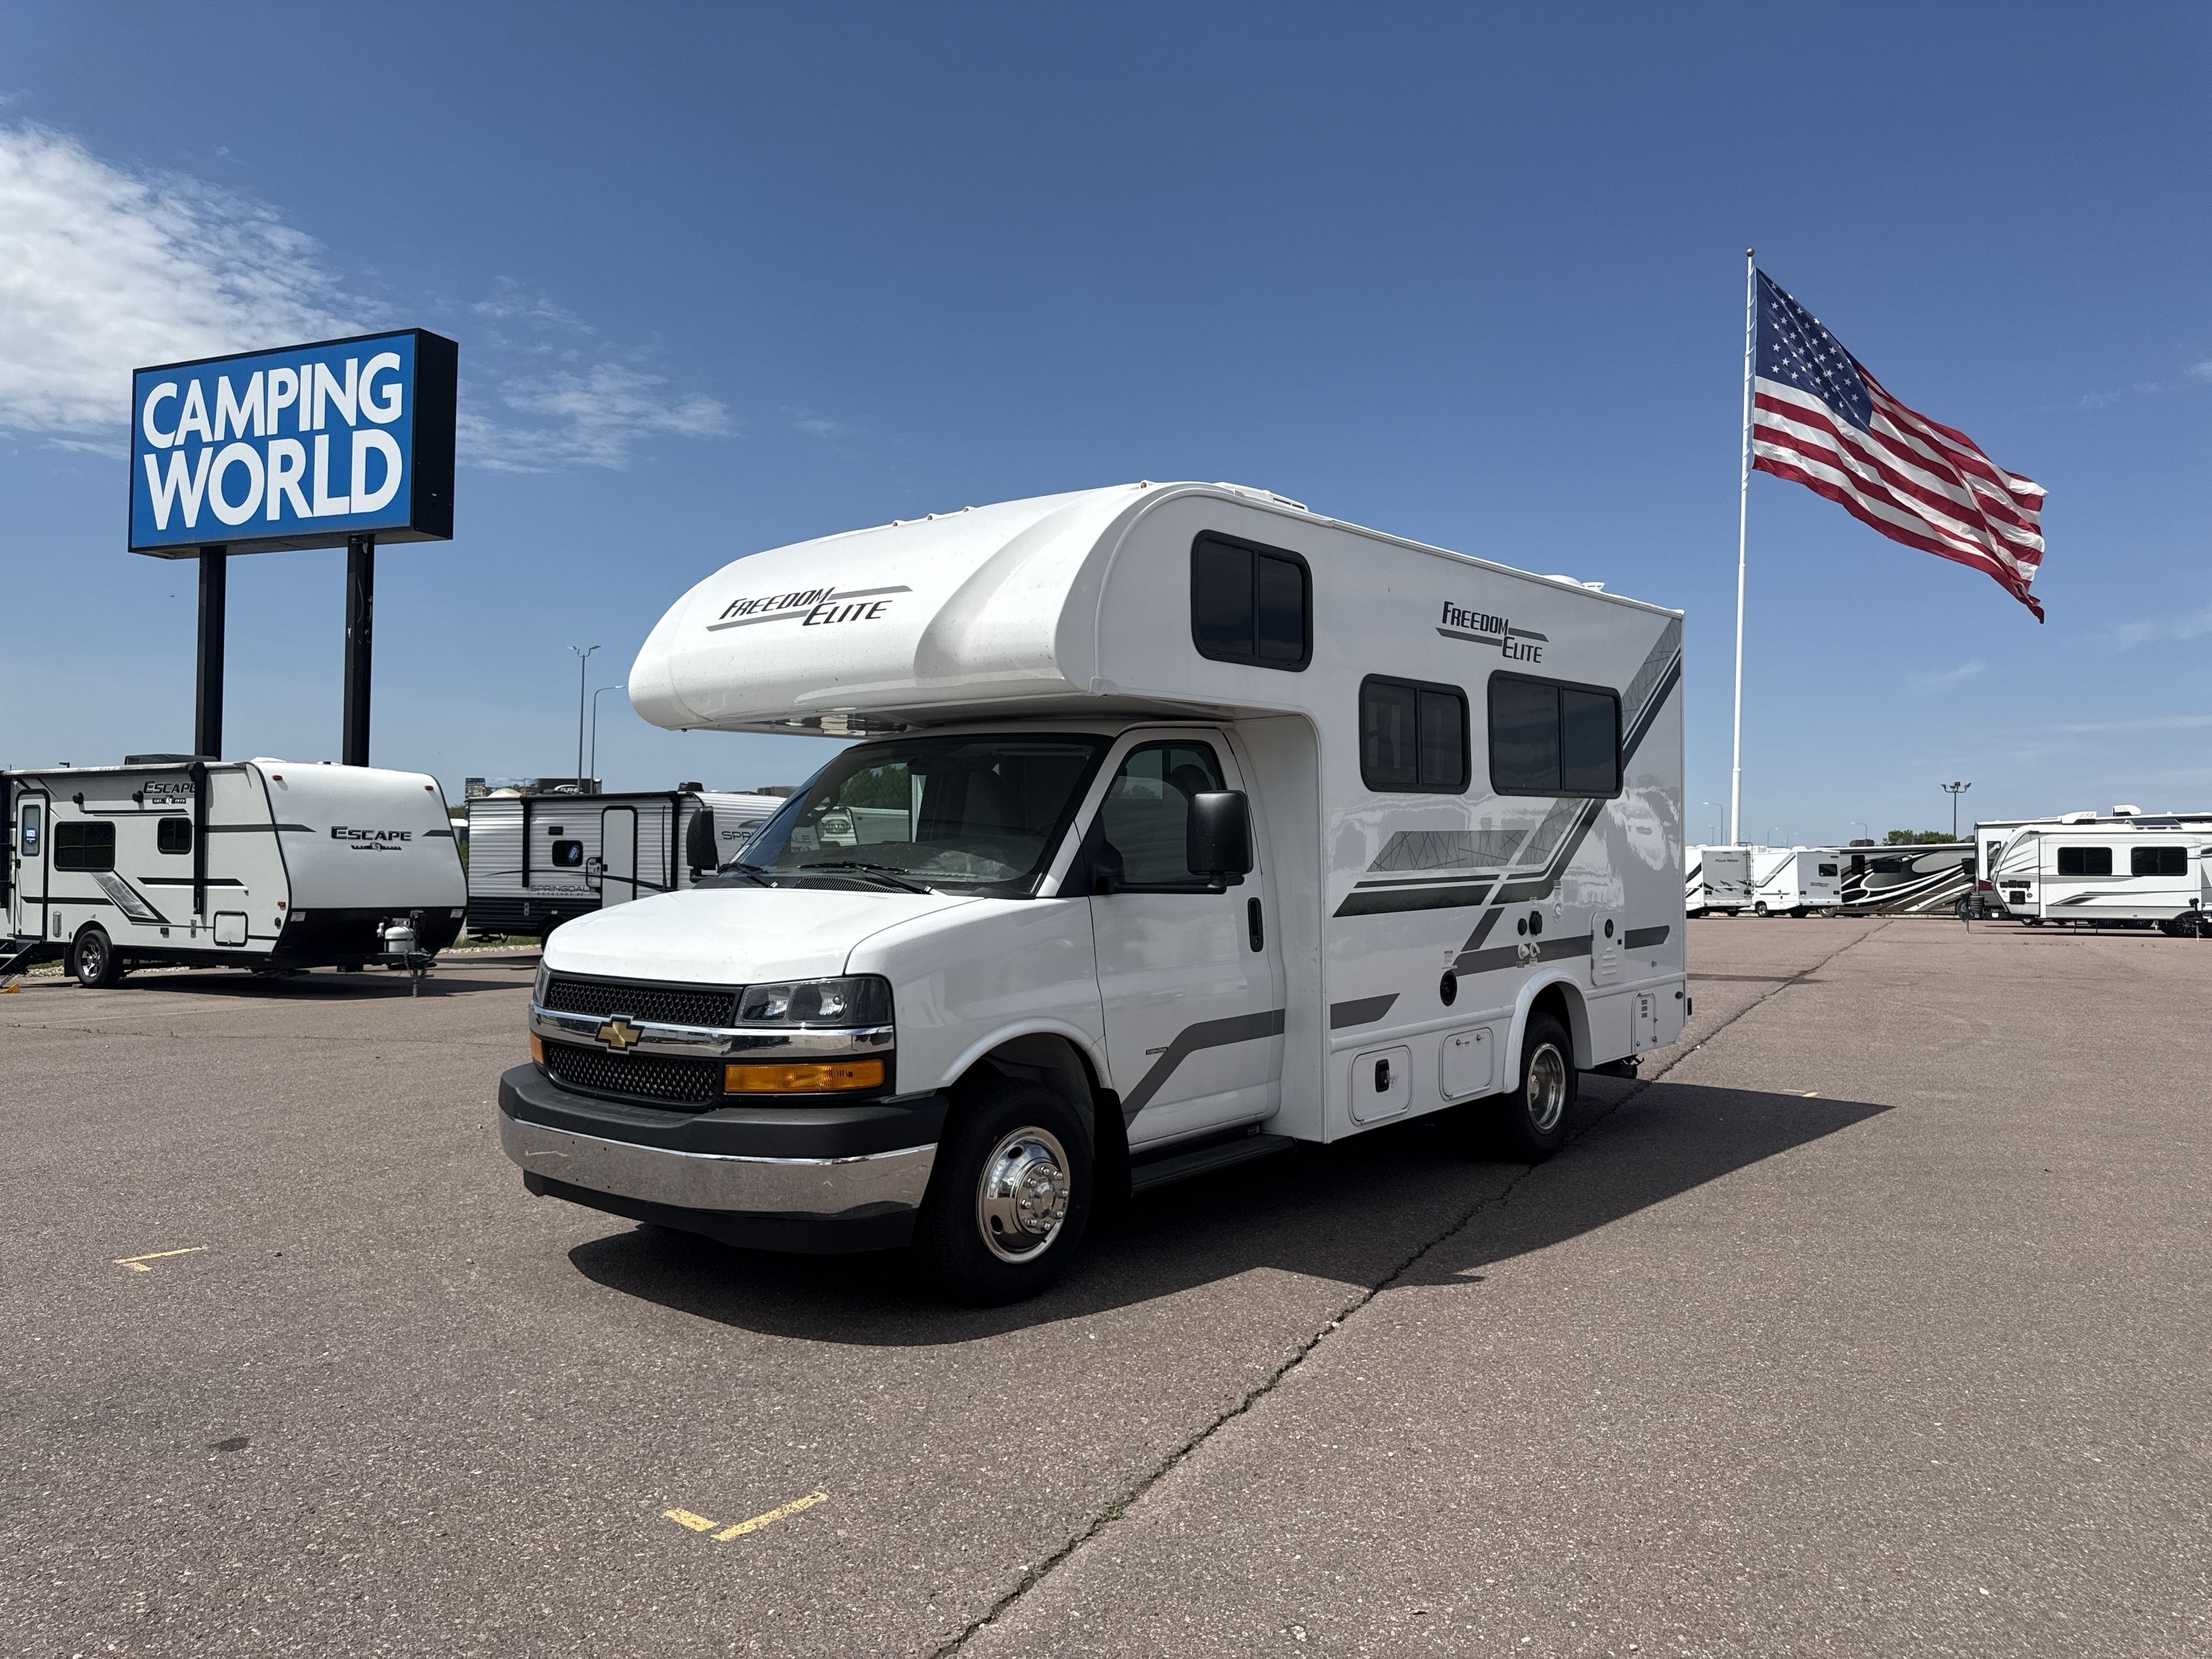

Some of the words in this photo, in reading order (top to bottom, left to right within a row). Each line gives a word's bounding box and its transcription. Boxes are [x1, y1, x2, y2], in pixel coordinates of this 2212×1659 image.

[142, 352, 403, 449] CAMPING
[143, 429, 403, 531] WORLD
[718, 586, 836, 620] FREEDOM
[802, 599, 894, 627] ELITE
[1441, 601, 1509, 636] FREEDOM
[1502, 636, 1543, 664] ELITE
[331, 826, 412, 841] ESCAPE
